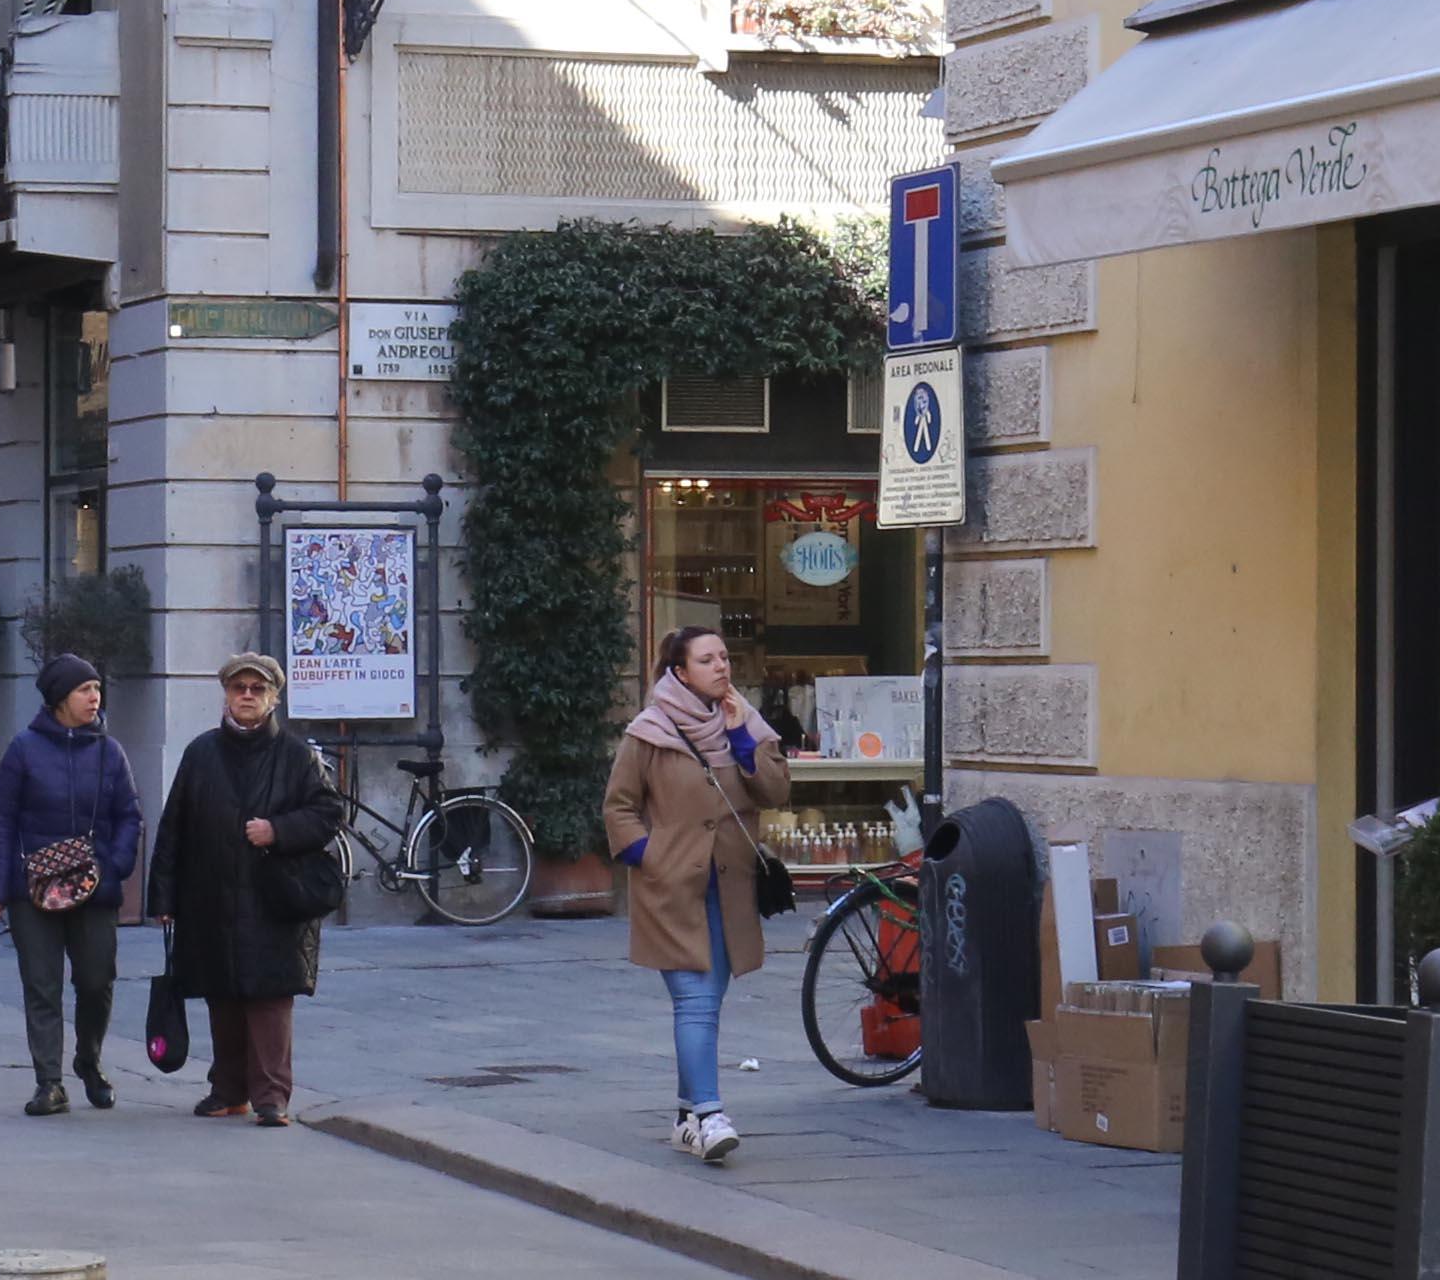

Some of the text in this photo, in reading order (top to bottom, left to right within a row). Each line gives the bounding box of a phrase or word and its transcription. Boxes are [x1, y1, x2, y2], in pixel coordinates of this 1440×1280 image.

[1191, 121, 1367, 228] Bottega Verde
[404, 311, 429, 322] VIA
[368, 328, 392, 339] DON
[376, 344, 456, 360] ANDREOLI
[890, 358, 954, 379] AREA PEDONALE
[291, 657, 362, 669] JEAN L'ARTE
[292, 668, 405, 681] DUBUFFET IN GIOCO
